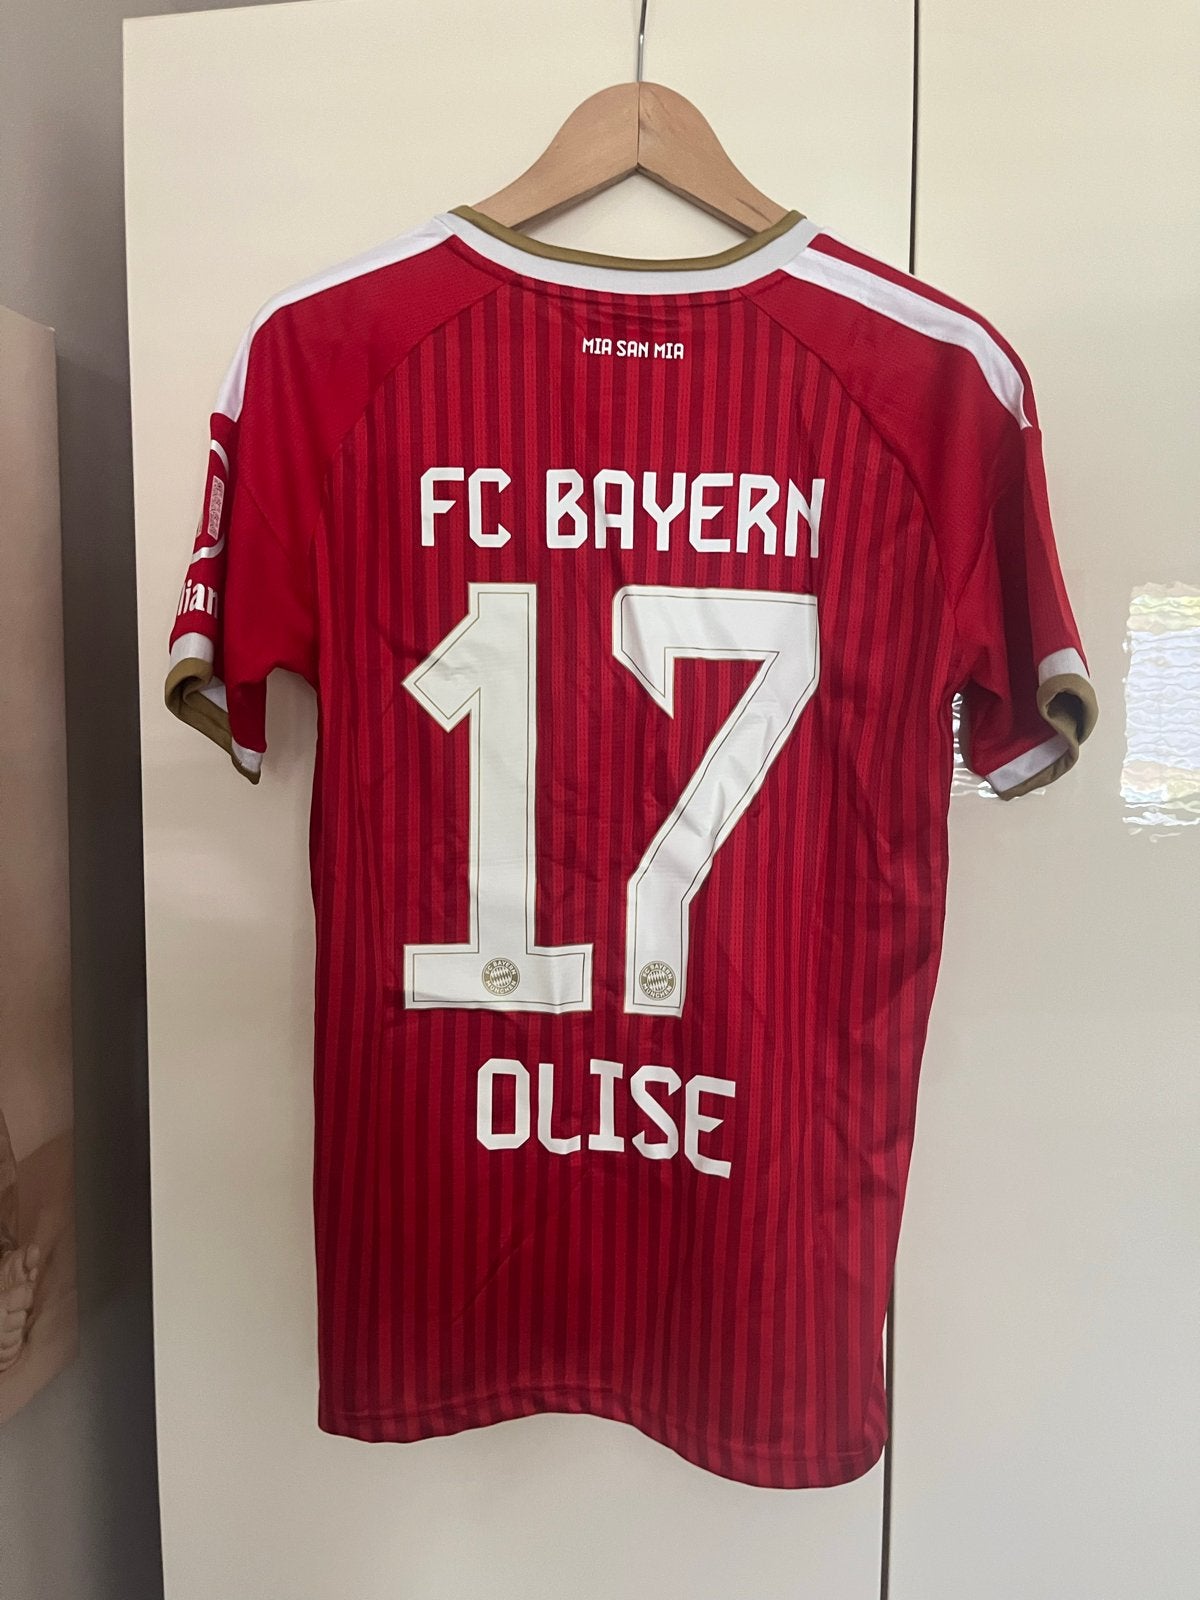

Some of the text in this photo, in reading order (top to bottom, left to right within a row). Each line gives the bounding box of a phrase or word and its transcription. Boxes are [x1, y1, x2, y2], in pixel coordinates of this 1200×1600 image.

[582, 337, 685, 360] MIA SAN MIA
[420, 466, 825, 559] FC BAYERN
[402, 582, 821, 1018] 17
[476, 1058, 736, 1179] OLISE
